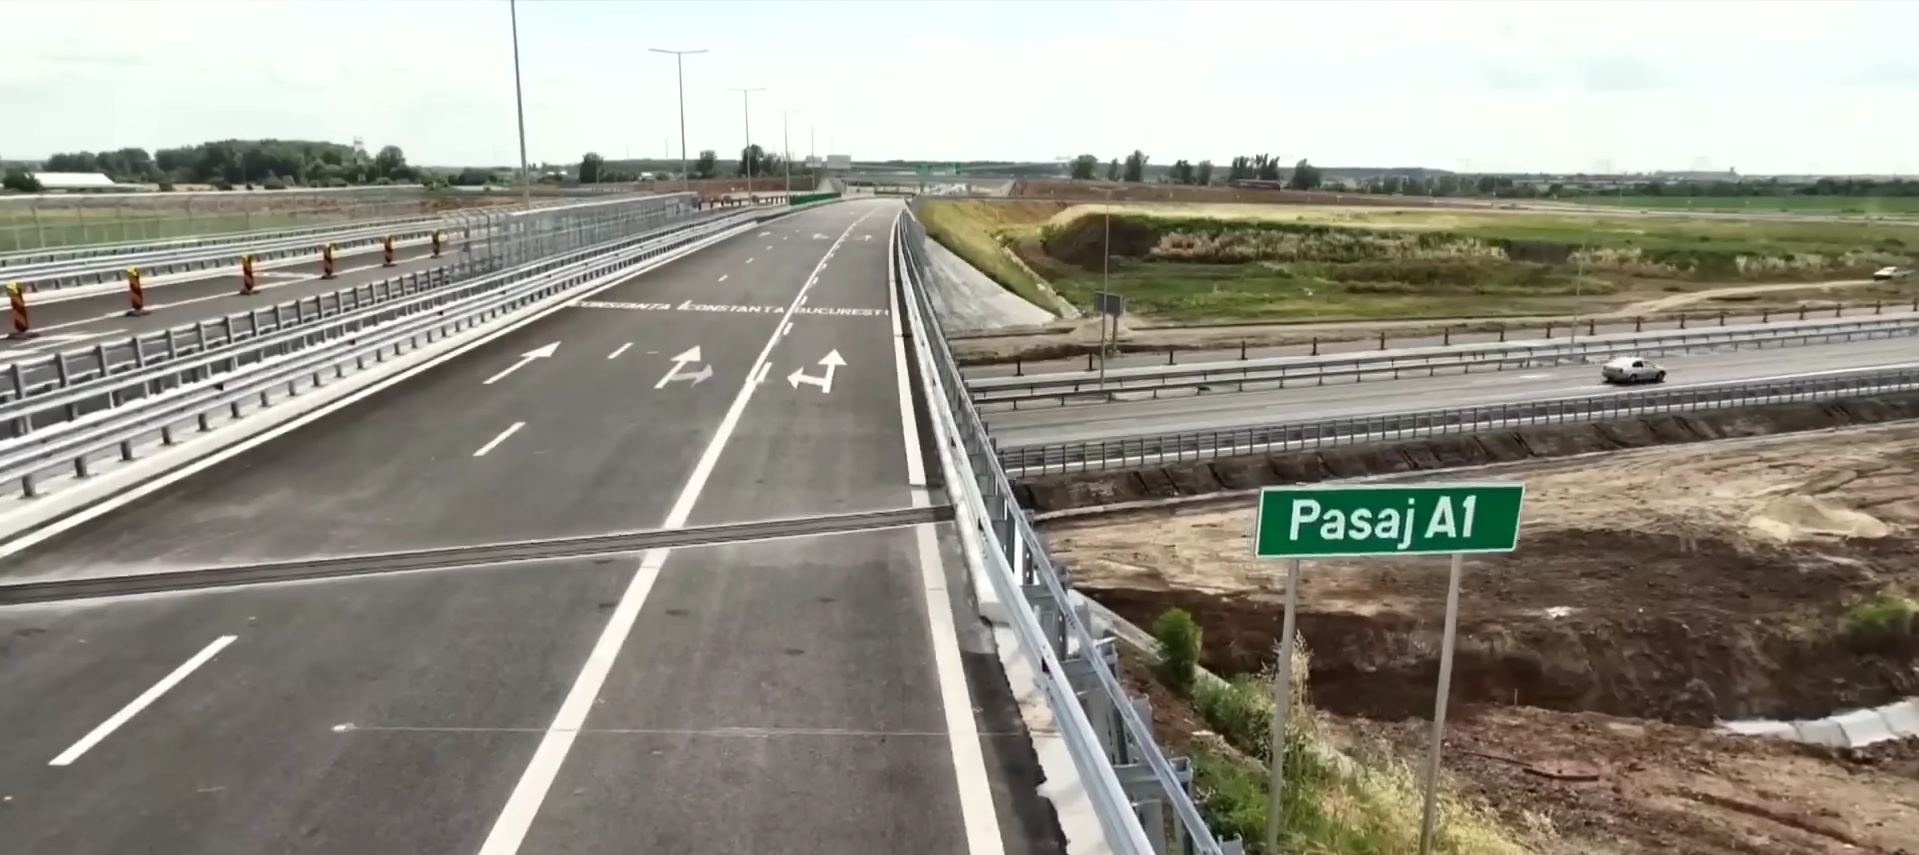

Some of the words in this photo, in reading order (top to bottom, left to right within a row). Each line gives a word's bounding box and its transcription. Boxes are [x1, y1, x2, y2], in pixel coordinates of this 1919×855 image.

[687, 303, 785, 313] CONSTANTA
[1289, 498, 1415, 550] Pasaj
[1424, 495, 1477, 539] A1
